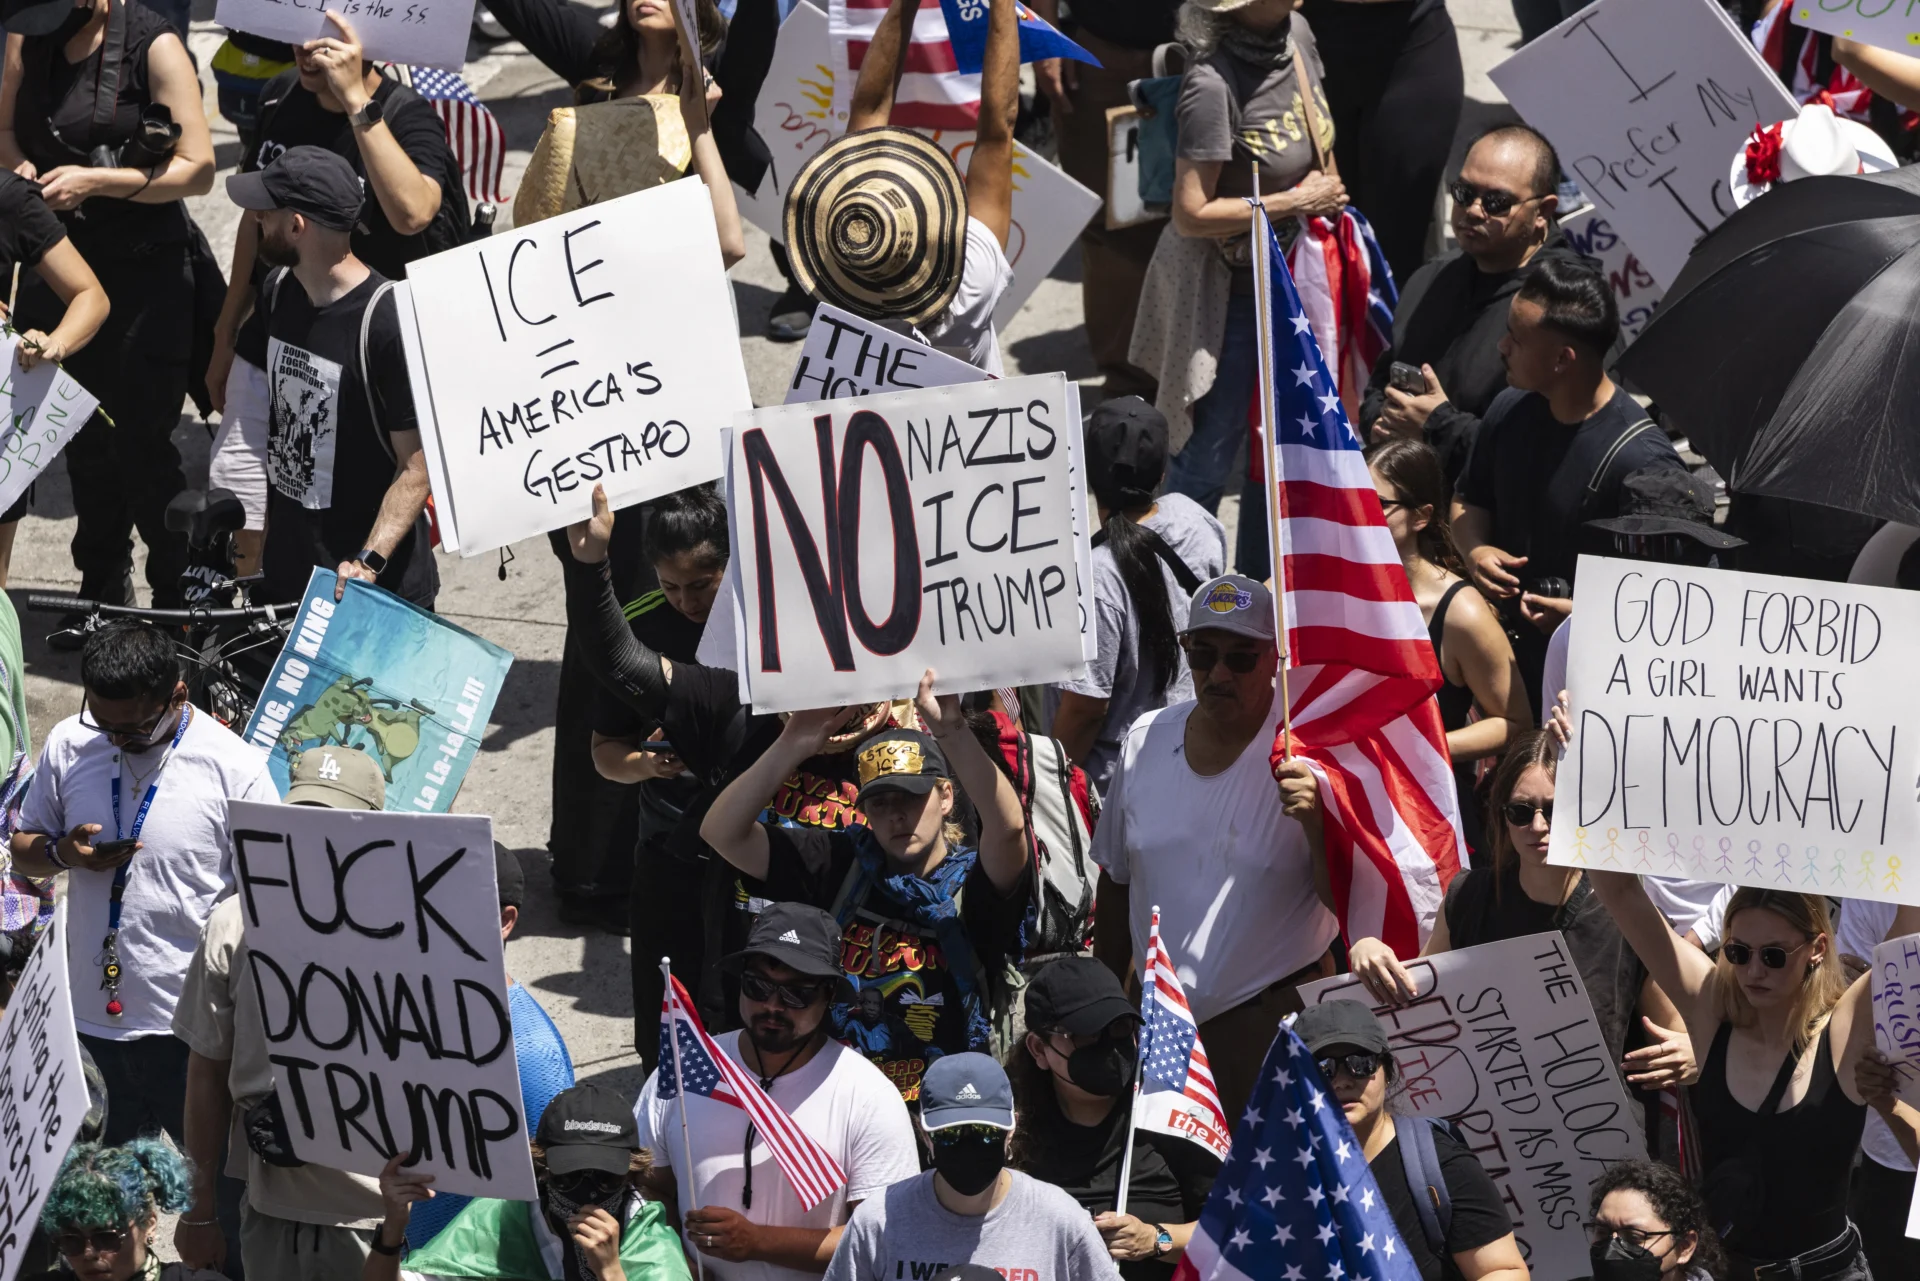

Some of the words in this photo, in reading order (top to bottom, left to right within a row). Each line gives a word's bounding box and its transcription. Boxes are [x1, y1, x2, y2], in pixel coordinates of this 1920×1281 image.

[343, 2, 360, 15] is
[366, 2, 393, 19] the
[1563, 10, 1677, 103] I
[1572, 121, 1681, 210] Prefer
[1696, 77, 1761, 128] My
[479, 220, 615, 342] ICE
[281, 355, 319, 377] TOGETHER
[283, 345, 311, 362] BOUND
[819, 314, 928, 389] THE
[480, 361, 662, 455] AMERICA'S
[907, 399, 1056, 481] NAZIS
[523, 420, 690, 504] GESTAPO
[742, 410, 923, 673] NO
[923, 476, 1059, 568] ICE
[275, 657, 310, 697] NO
[294, 596, 336, 660] KING
[923, 565, 1066, 645] TRUMP
[1614, 572, 1714, 647] GOD
[1740, 589, 1881, 665] FORBID
[1605, 653, 1631, 695] A
[1648, 658, 1716, 697] GIRL
[1739, 664, 1846, 710] WANTS
[318, 753, 341, 780] LA
[413, 785, 439, 811] La
[1578, 709, 1896, 845] DEMOCRACY
[233, 829, 488, 962] FUCK
[778, 936, 800, 945] adidas
[1533, 939, 1579, 1005] THE
[248, 949, 511, 1067] DONALD
[1456, 986, 1541, 1115] STARTED
[40, 1059, 65, 1153] the
[955, 1093, 982, 1101] adidas
[1173, 1113, 1209, 1141] the
[1212, 1138, 1229, 1157] re
[1533, 1018, 1629, 1188] HOLOCA
[1508, 1128, 1558, 1159] AS
[1525, 1160, 1581, 1231] MASS
